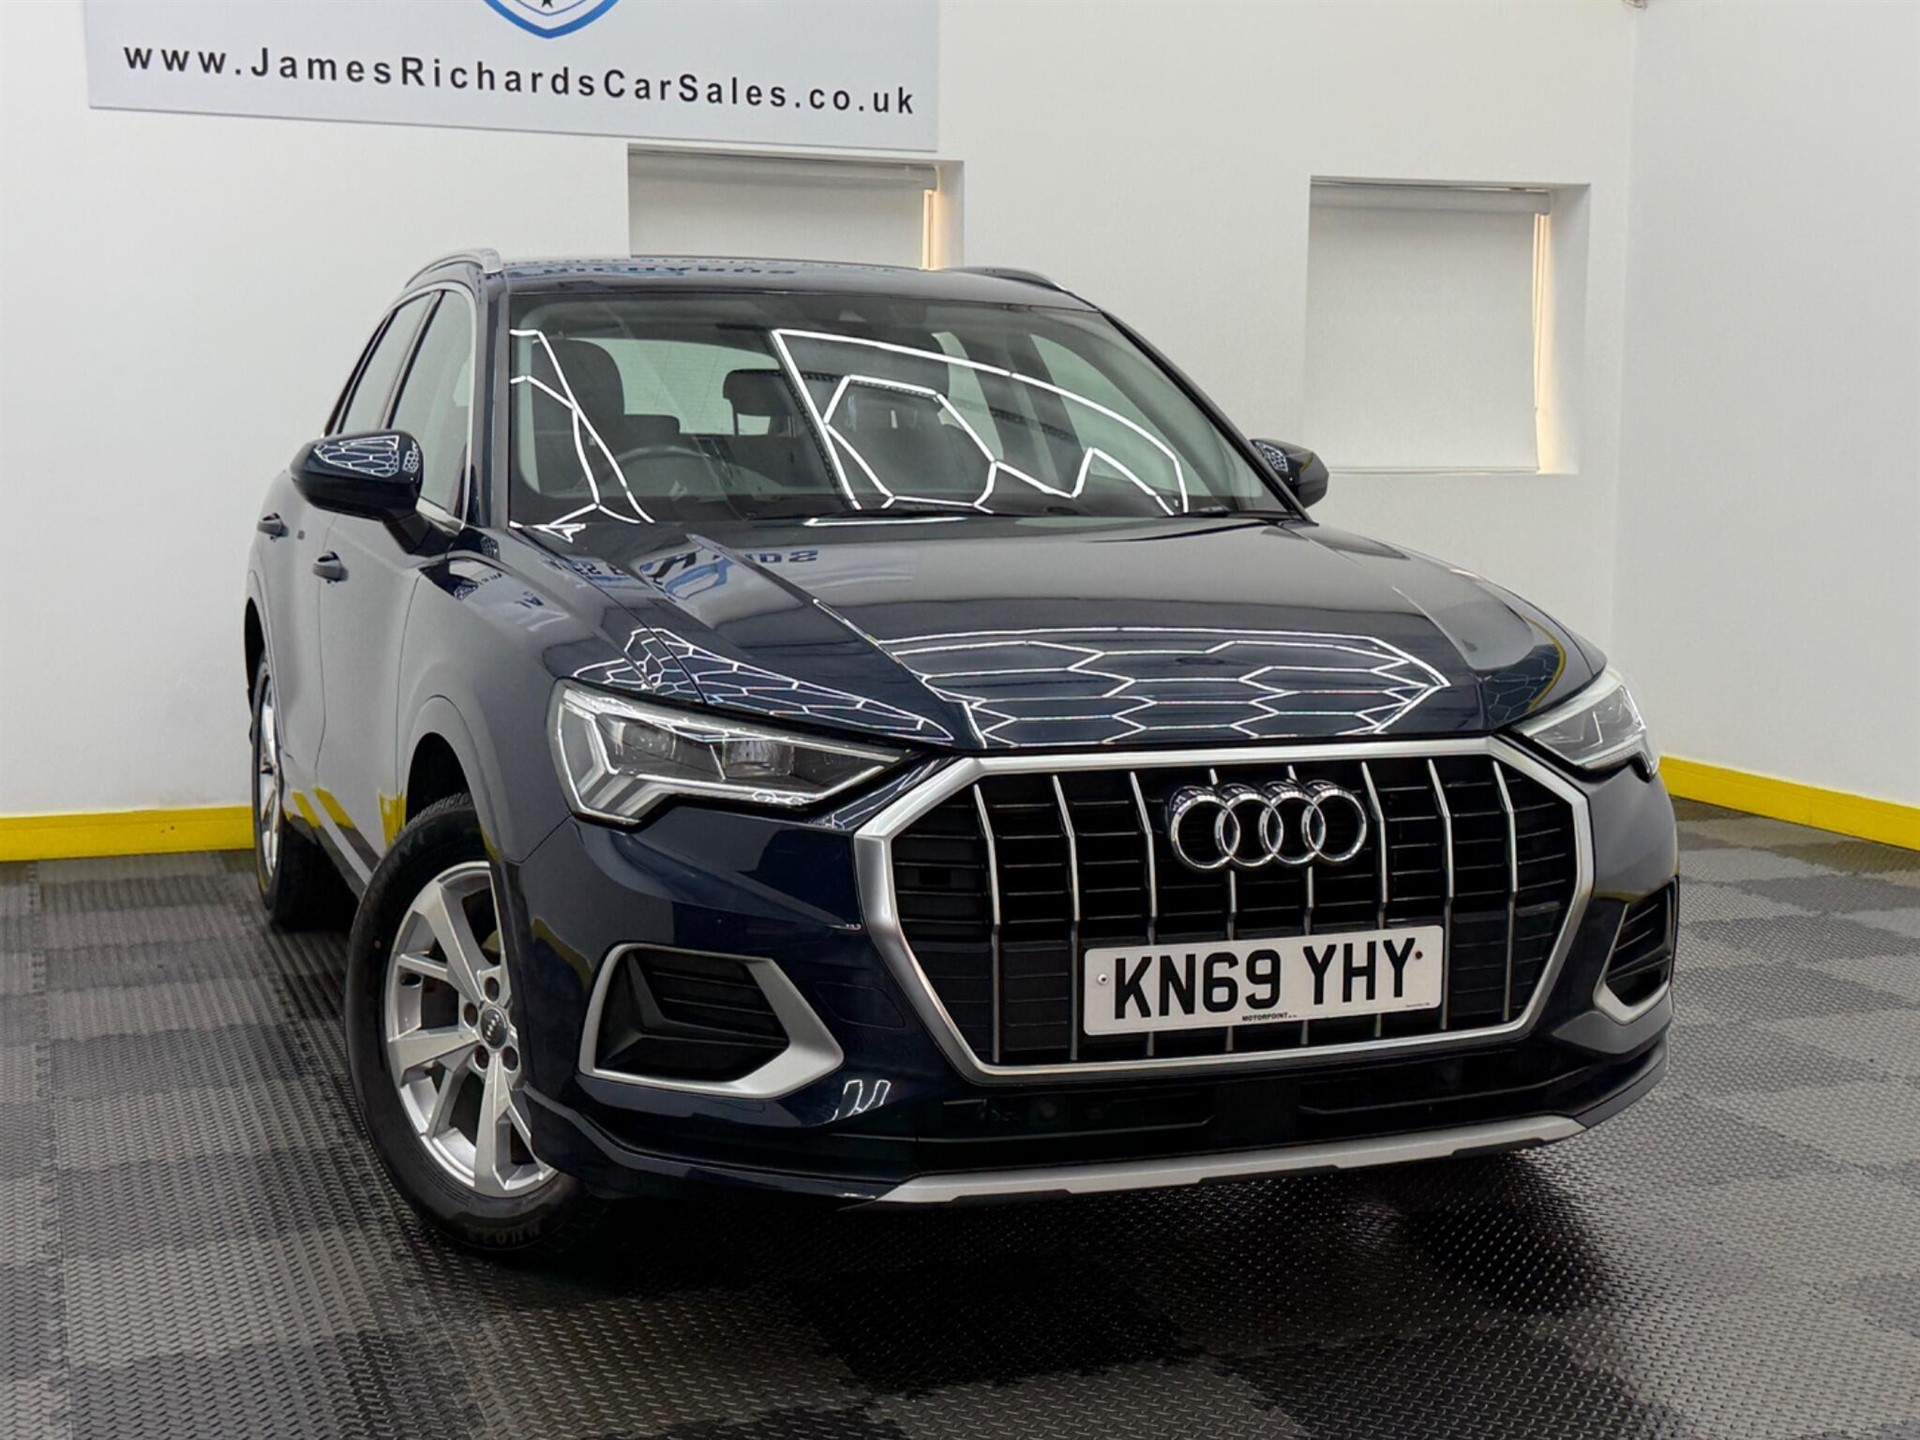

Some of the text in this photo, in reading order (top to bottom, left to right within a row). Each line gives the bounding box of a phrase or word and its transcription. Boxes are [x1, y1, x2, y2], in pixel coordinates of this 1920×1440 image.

[123, 46, 914, 116] www.JamesRichardsCarSales.co.uk
[1114, 936, 1416, 1020] KN69 YHY
